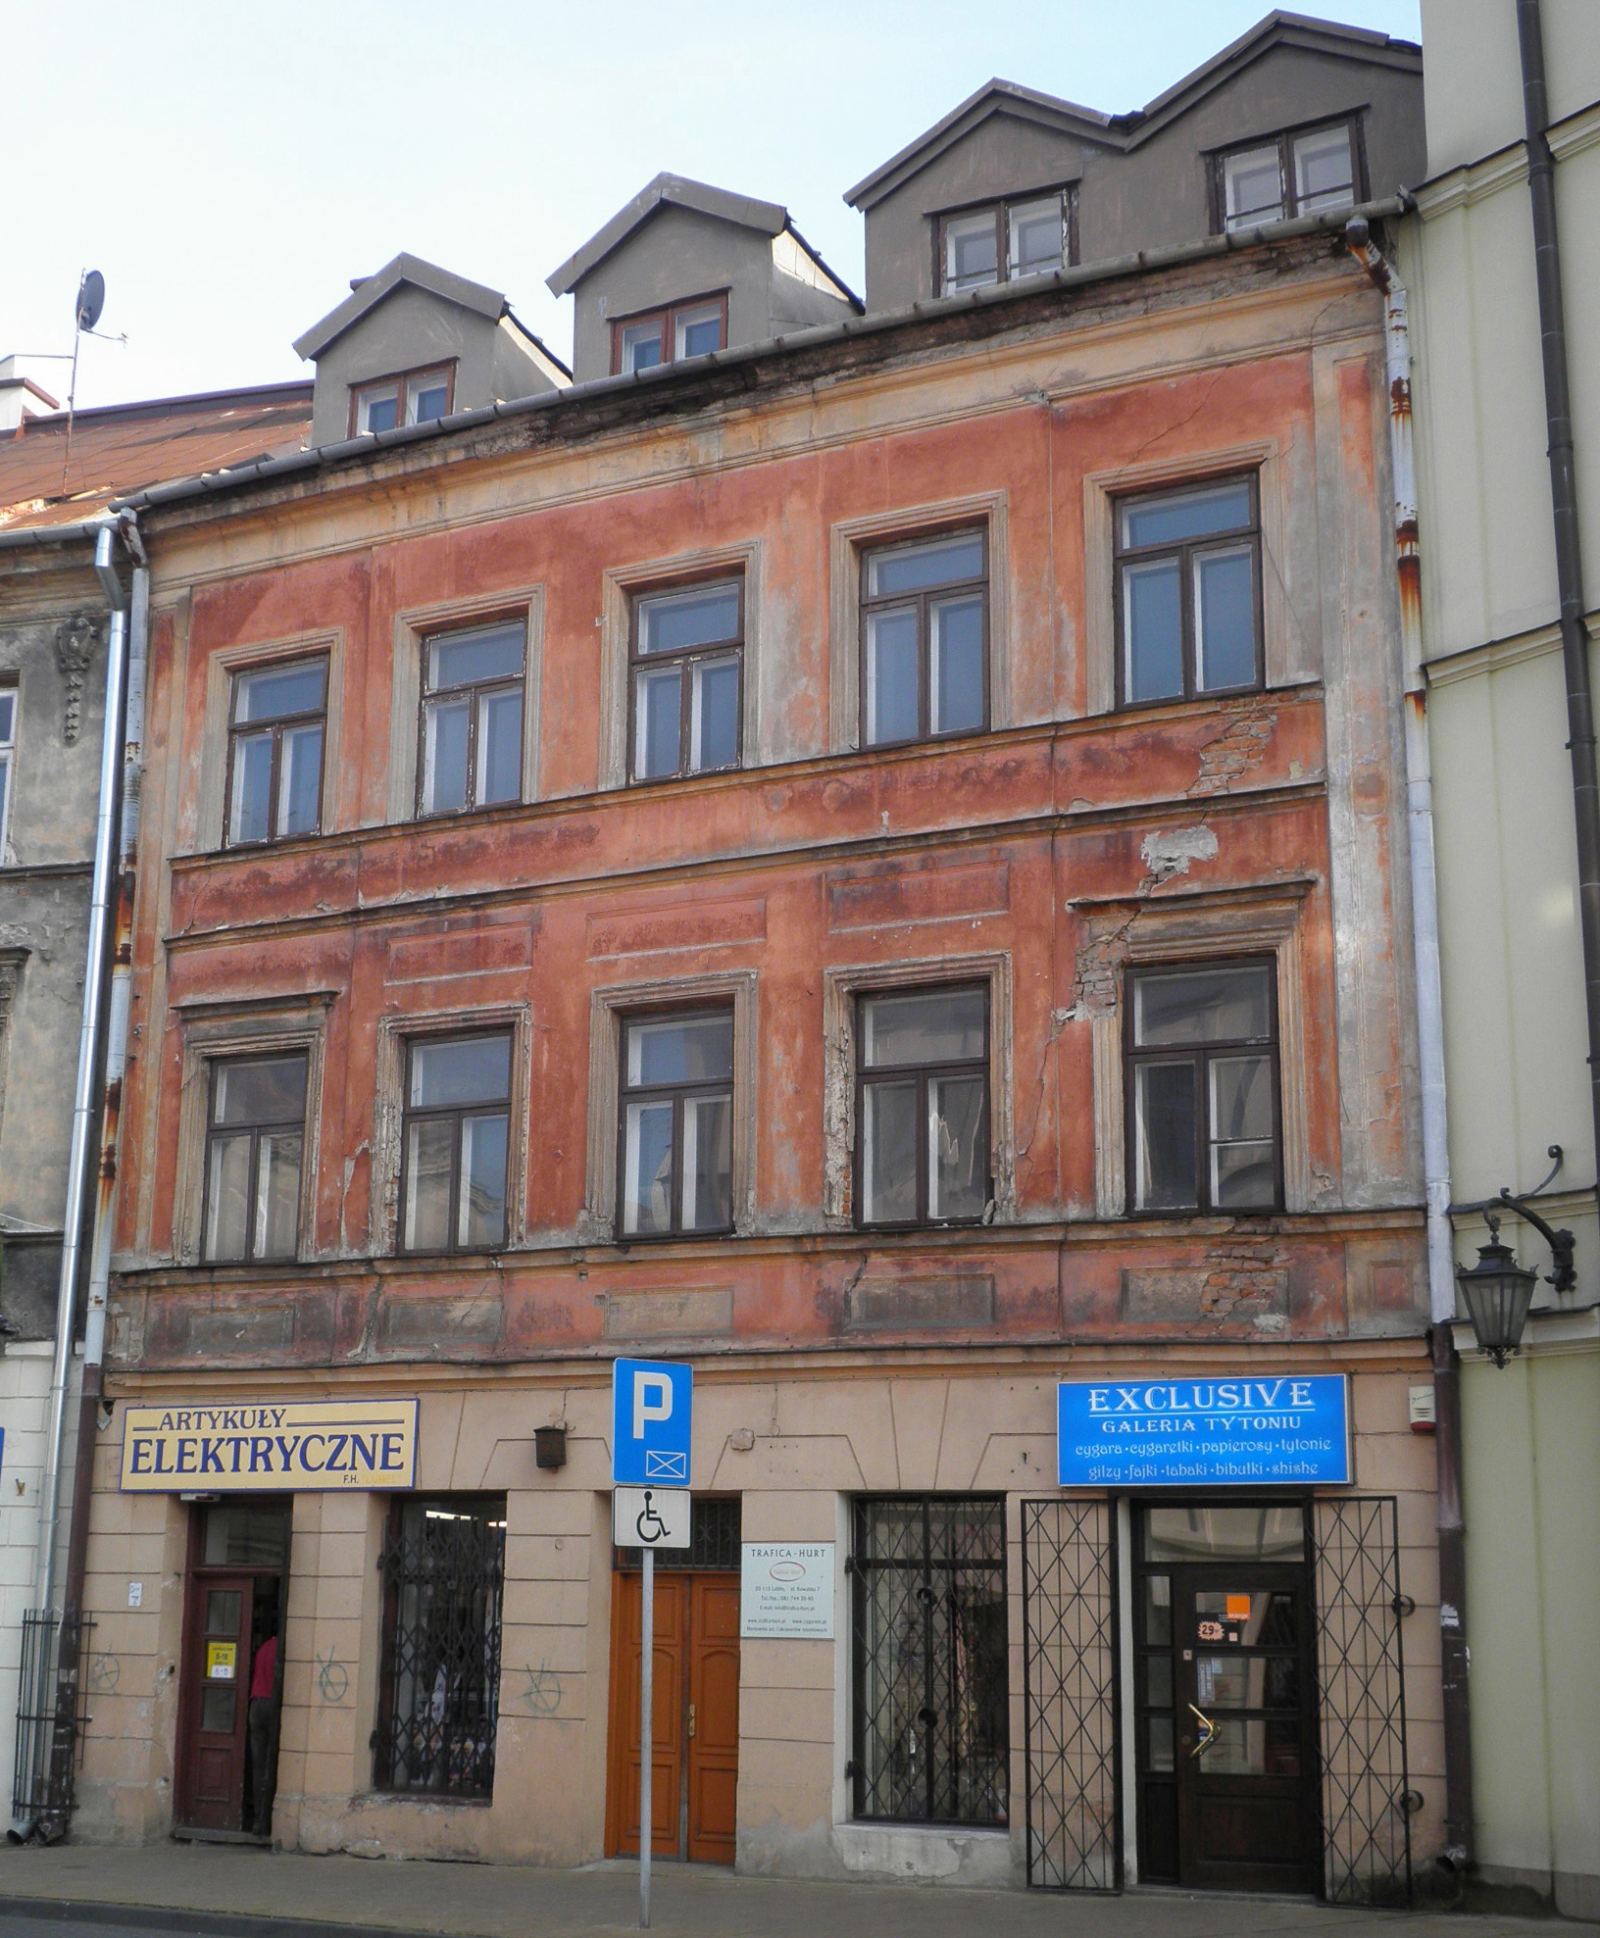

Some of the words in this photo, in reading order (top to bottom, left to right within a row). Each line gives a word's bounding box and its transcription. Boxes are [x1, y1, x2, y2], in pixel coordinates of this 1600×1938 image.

[633, 1371, 673, 1439] P
[1088, 1379, 1315, 1412] EXCLUSIVE
[158, 1408, 287, 1431] ARTYKUŁY
[1102, 1418, 1196, 1433] GALERIA
[1204, 1415, 1302, 1431] TYTONIU
[130, 1433, 405, 1474] ELEKTRYCZNE
[1075, 1443, 1122, 1458] cygara
